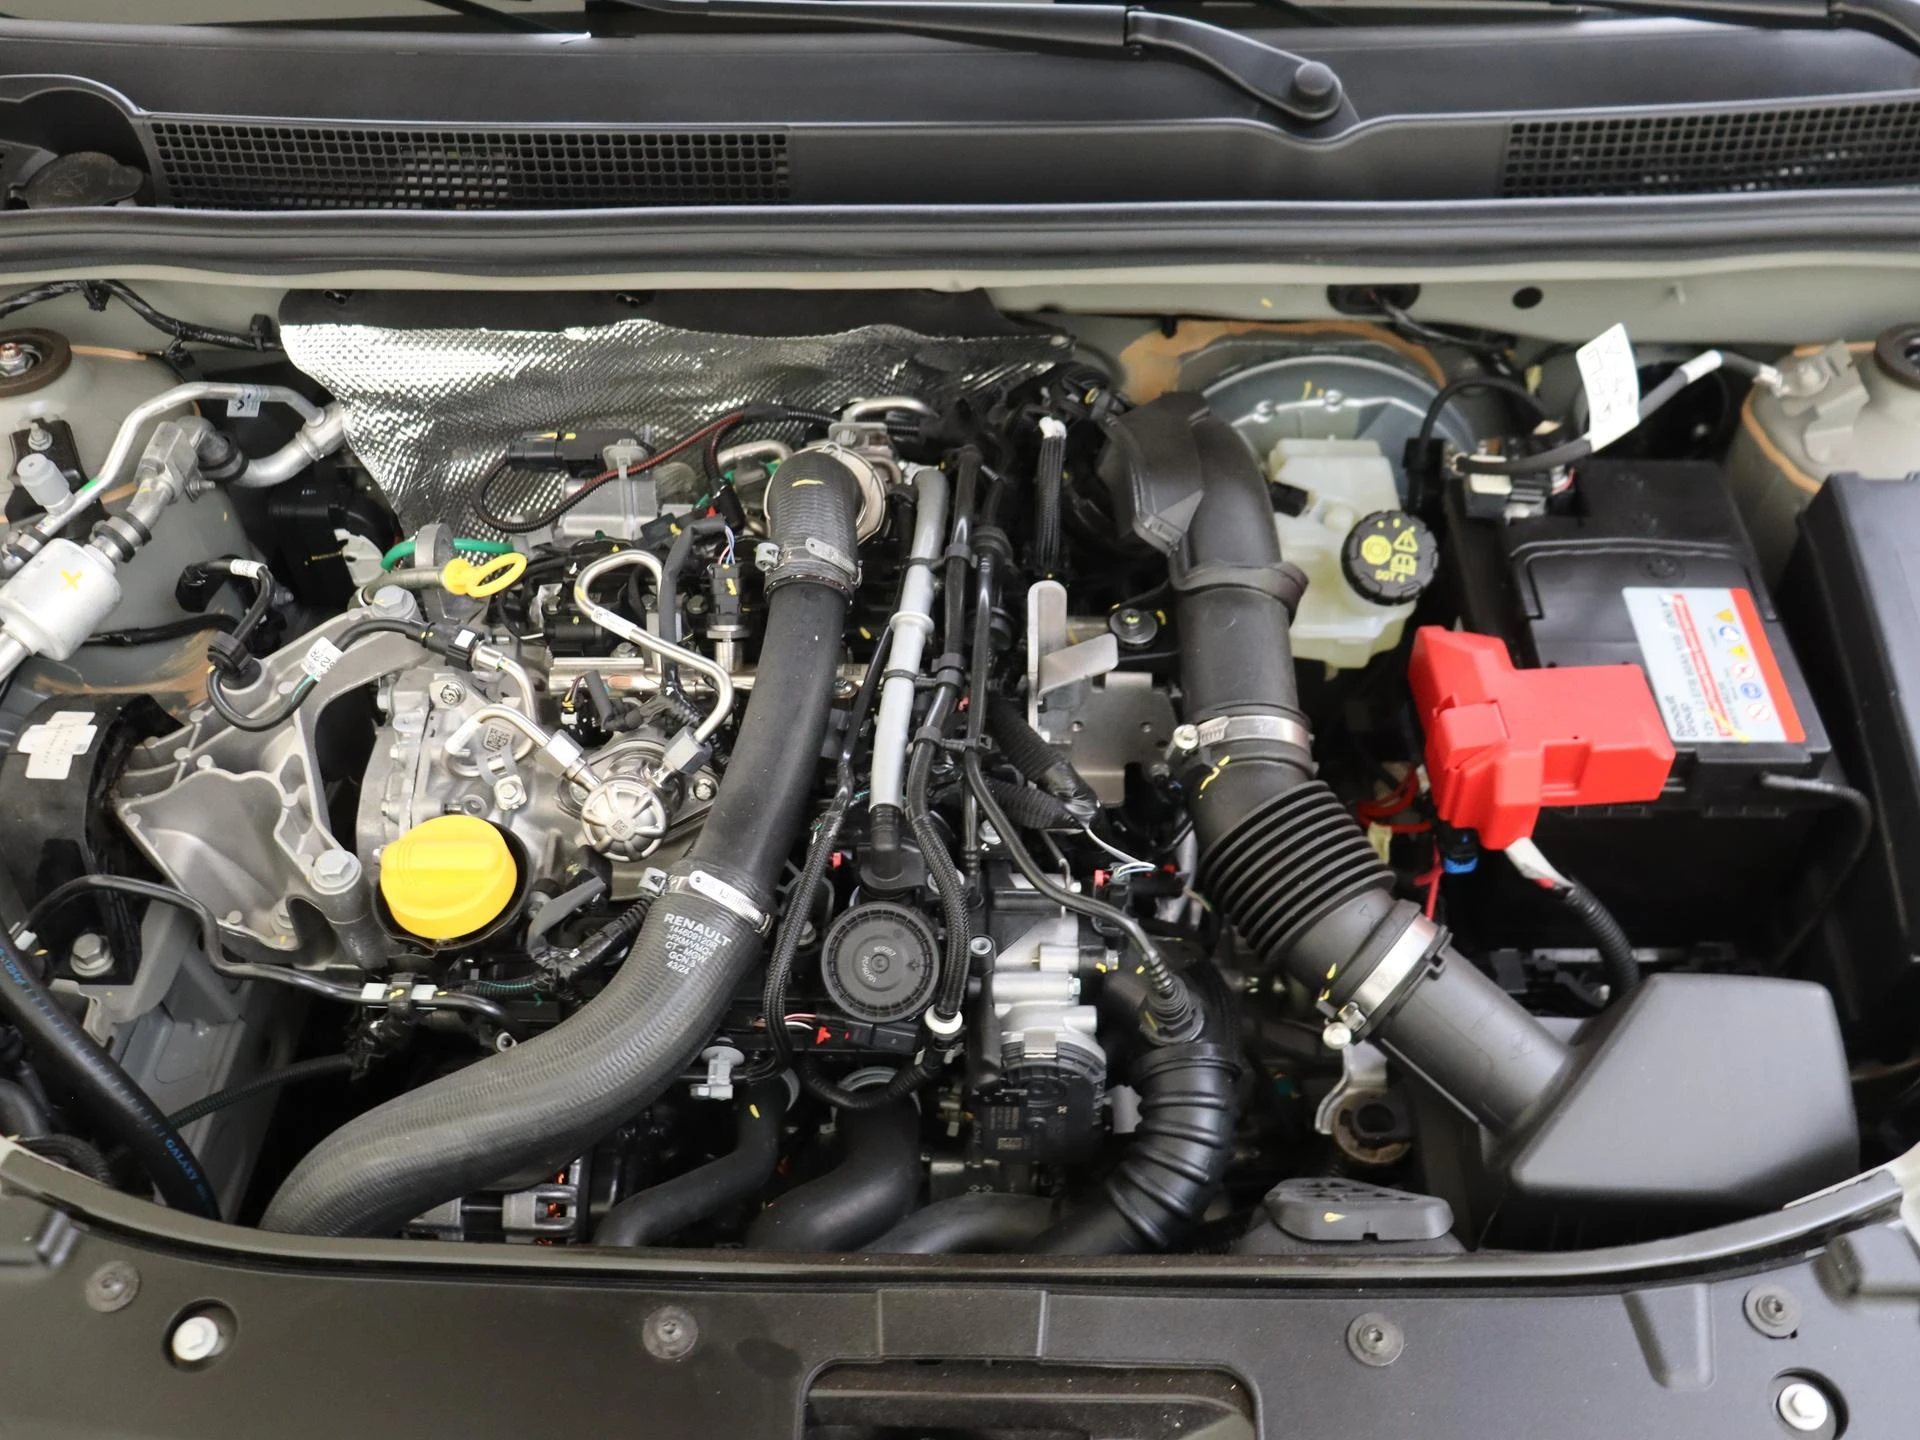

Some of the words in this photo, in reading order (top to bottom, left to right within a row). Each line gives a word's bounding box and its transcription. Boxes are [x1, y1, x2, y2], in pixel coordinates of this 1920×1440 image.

[663, 913, 732, 946] RENAULT
[665, 941, 679, 950] CT
[668, 951, 690, 964] GCN
[165, 1138, 200, 1180] GALAXY
